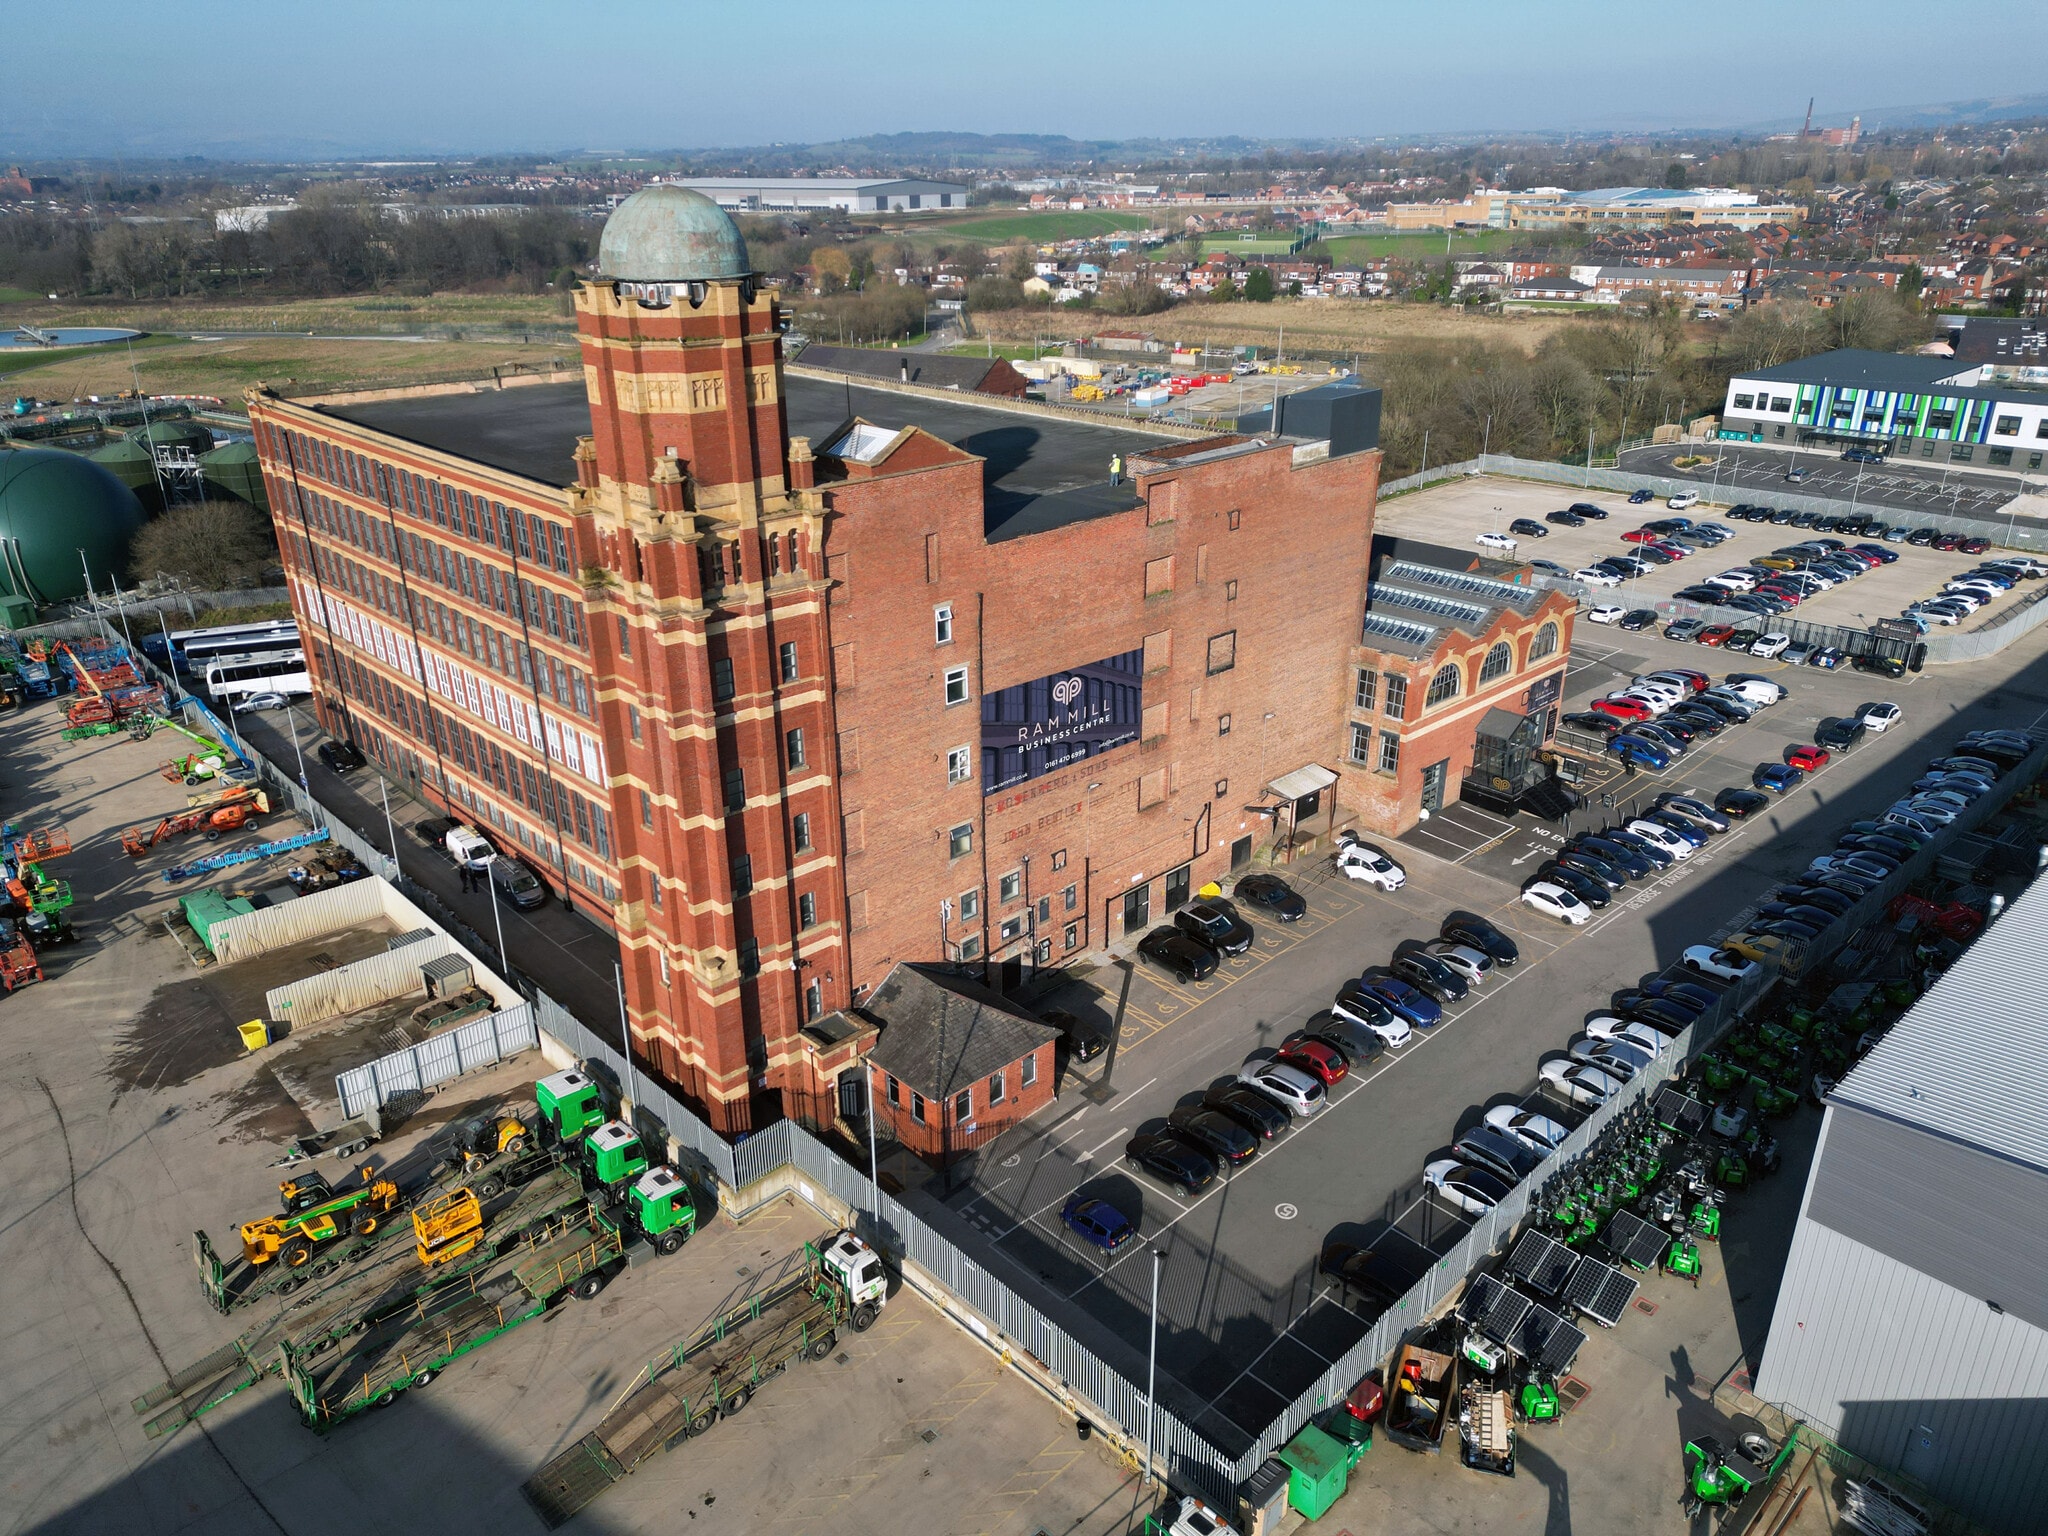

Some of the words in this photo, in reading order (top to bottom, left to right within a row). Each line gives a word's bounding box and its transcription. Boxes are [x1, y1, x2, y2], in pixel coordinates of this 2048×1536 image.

[1018, 718, 1059, 742] RAM
[1067, 699, 1111, 725] MILL
[1018, 729, 1071, 754] BUSINESS
[1073, 714, 1111, 734] CENTRE
[1044, 759, 1058, 769] 0161
[1059, 755, 1071, 763] 470
[1071, 748, 1086, 759] 6999
[1531, 826, 1551, 837] NO
[1526, 841, 1558, 856] EXIT
[1626, 888, 1662, 911] REVERSE
[1660, 867, 1694, 888] PARKING
[1692, 853, 1714, 866] ONLY
